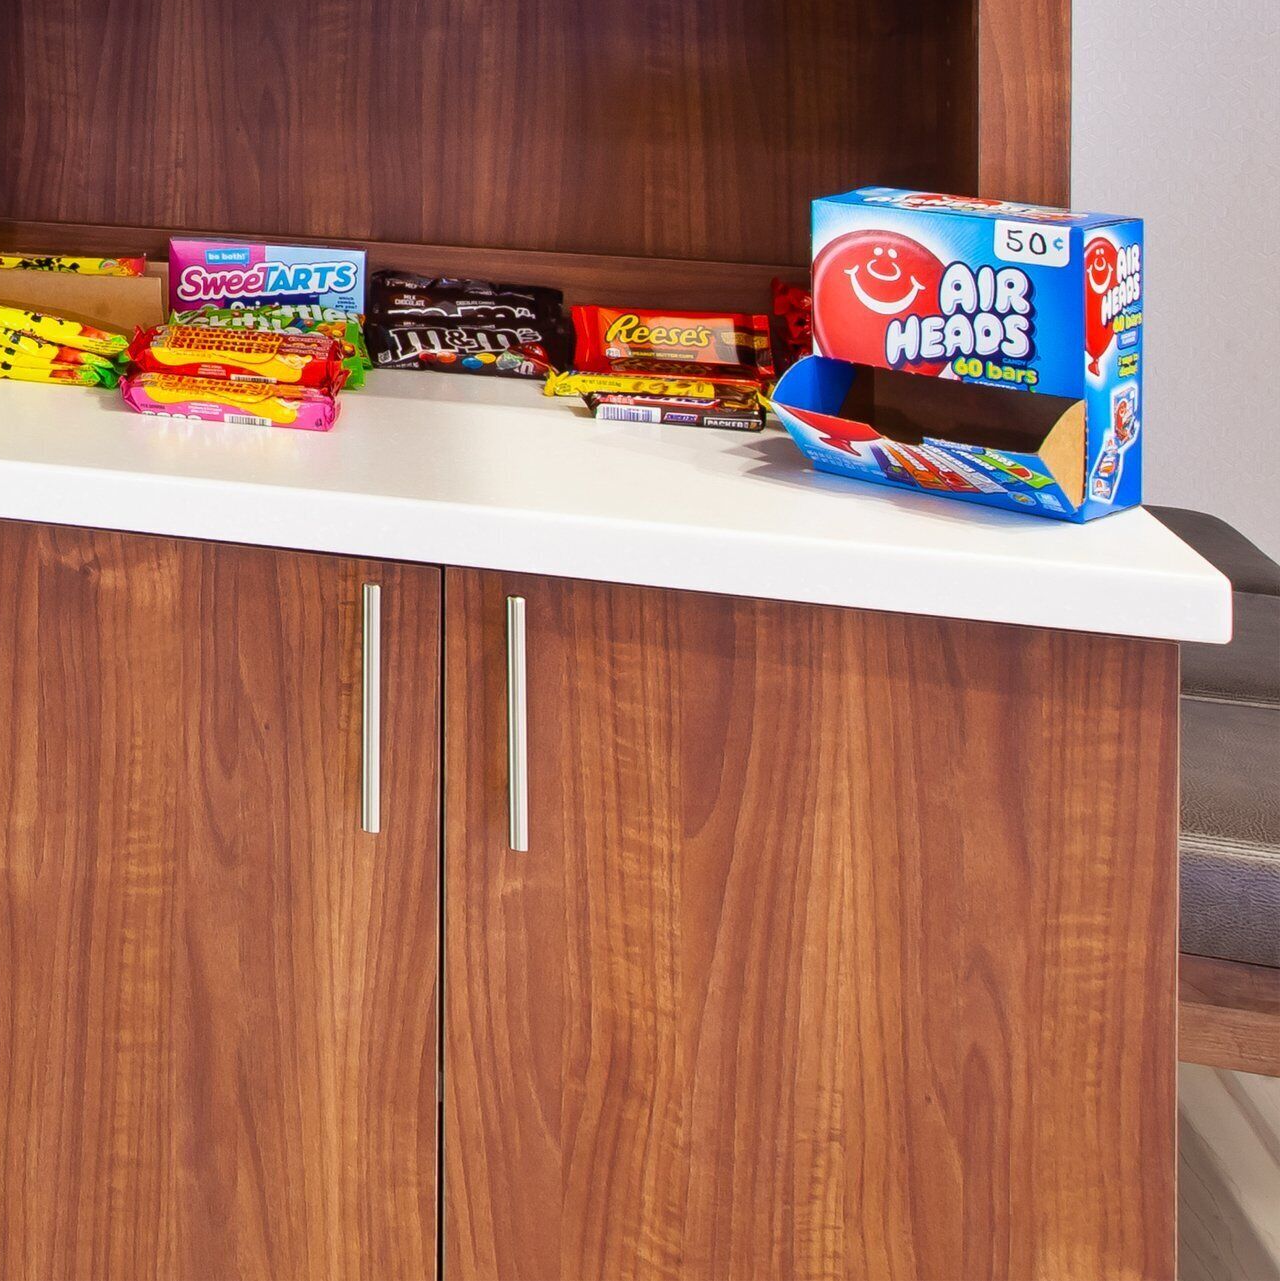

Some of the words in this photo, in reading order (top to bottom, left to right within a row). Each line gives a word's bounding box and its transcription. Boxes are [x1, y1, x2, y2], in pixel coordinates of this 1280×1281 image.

[1116, 244, 1140, 280] AIR
[940, 264, 1032, 314] AIR
[1102, 274, 1140, 325] HEADS
[606, 314, 712, 346] Reese's
[886, 314, 1031, 364] HEADS
[954, 358, 981, 377] 60
[986, 360, 1037, 383] bars
